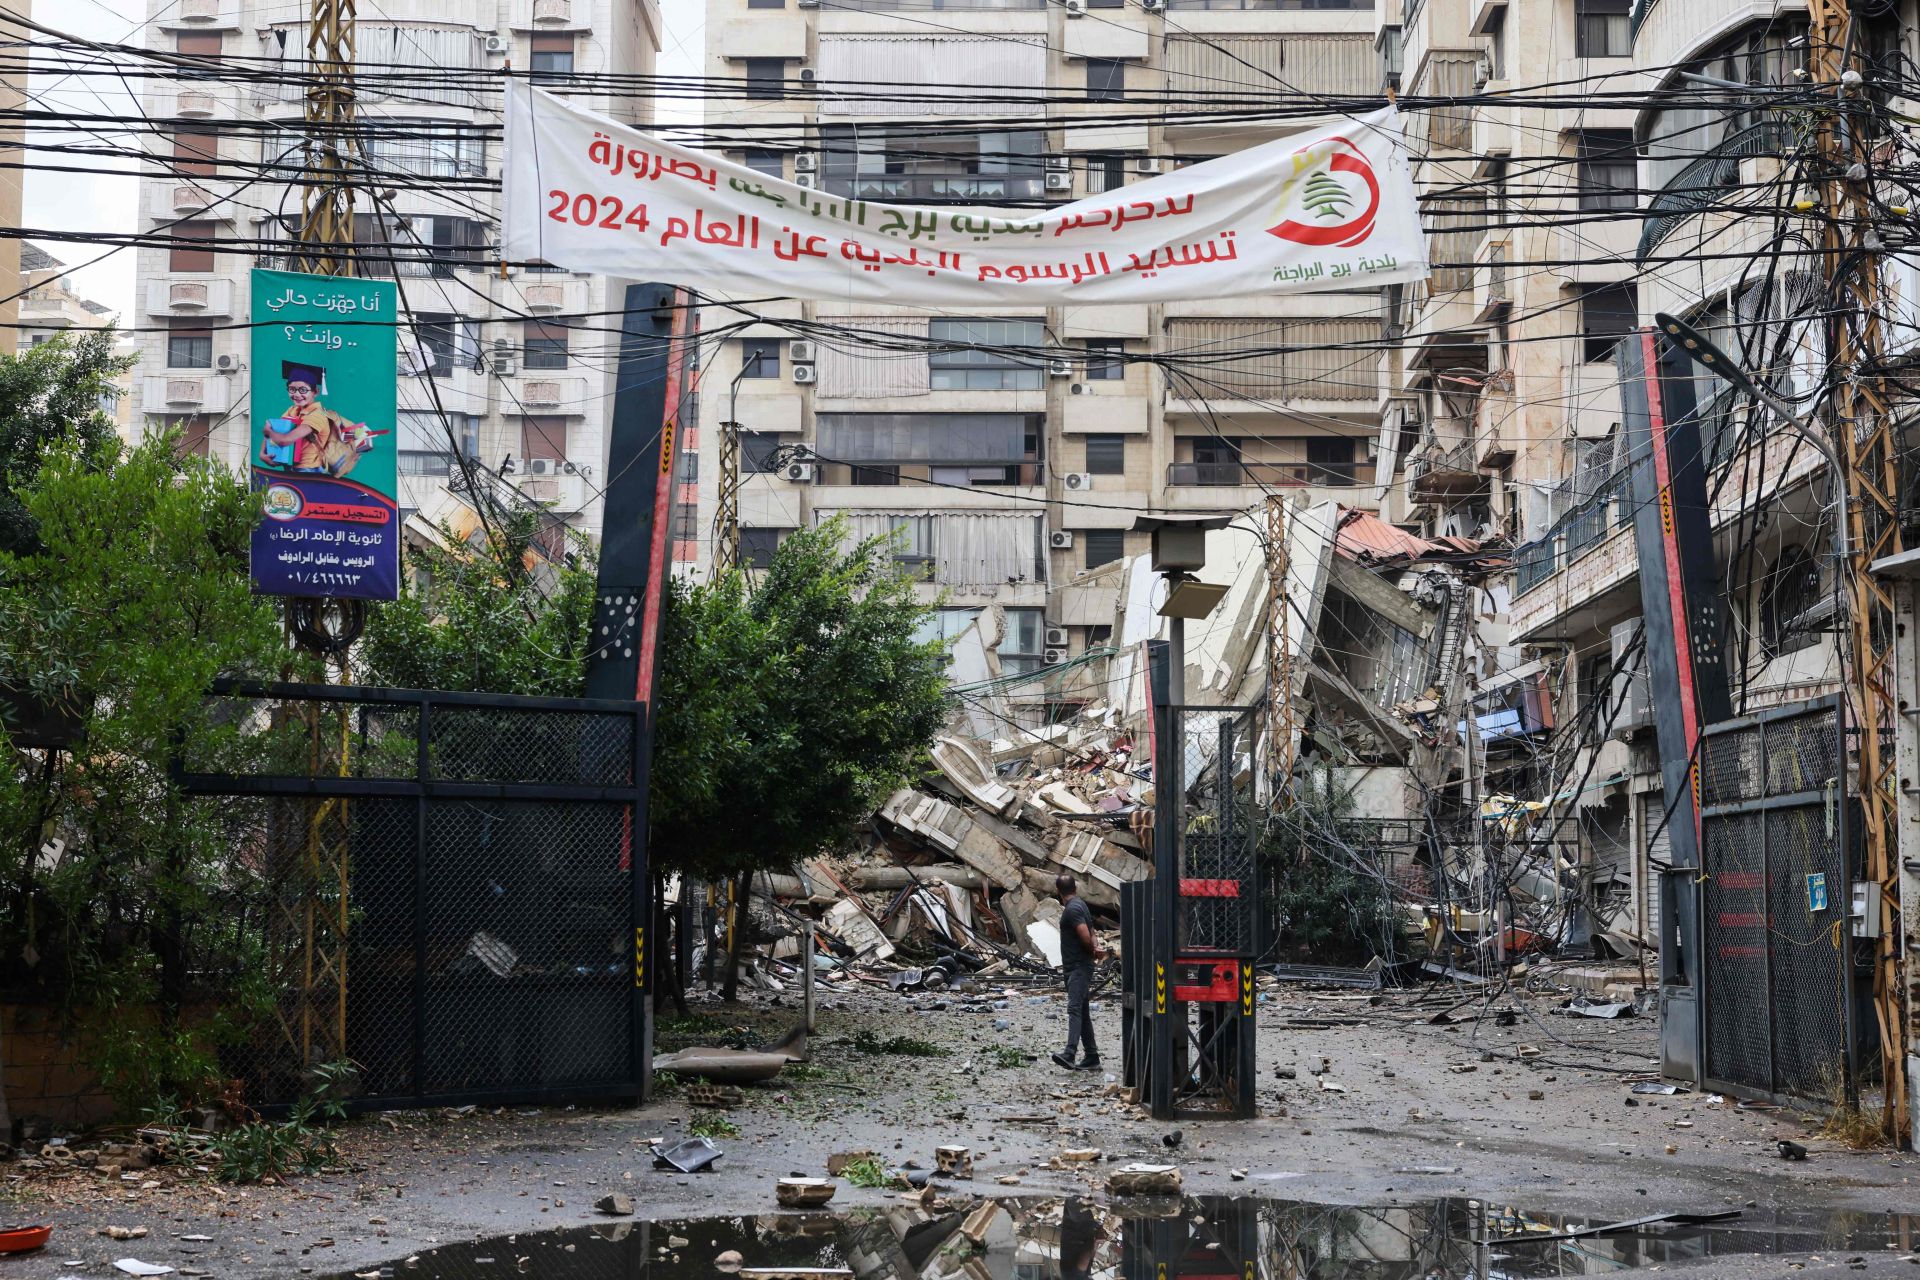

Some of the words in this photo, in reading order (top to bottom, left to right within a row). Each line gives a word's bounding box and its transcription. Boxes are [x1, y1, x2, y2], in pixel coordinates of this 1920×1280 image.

[548, 190, 650, 232] 2024
[660, 208, 760, 249] العام
[879, 209, 938, 241] برج
[774, 226, 828, 262] عن
[840, 238, 961, 276] البلدية
[1121, 231, 1237, 279] تسديد
[1358, 253, 1397, 273] بلدية
[978, 251, 1111, 284] الرسوم
[1273, 261, 1323, 283] البراجنة
[1330, 260, 1351, 278] برج
[266, 289, 308, 312] حالي
[361, 291, 380, 312] أنا
[304, 506, 340, 517] مستمر
[342, 508, 386, 520] التسجيل
[280, 527, 308, 541] الرضا
[311, 530, 346, 546] الإمام
[348, 532, 383, 546] ثانوية
[315, 552, 340, 565] مقابل
